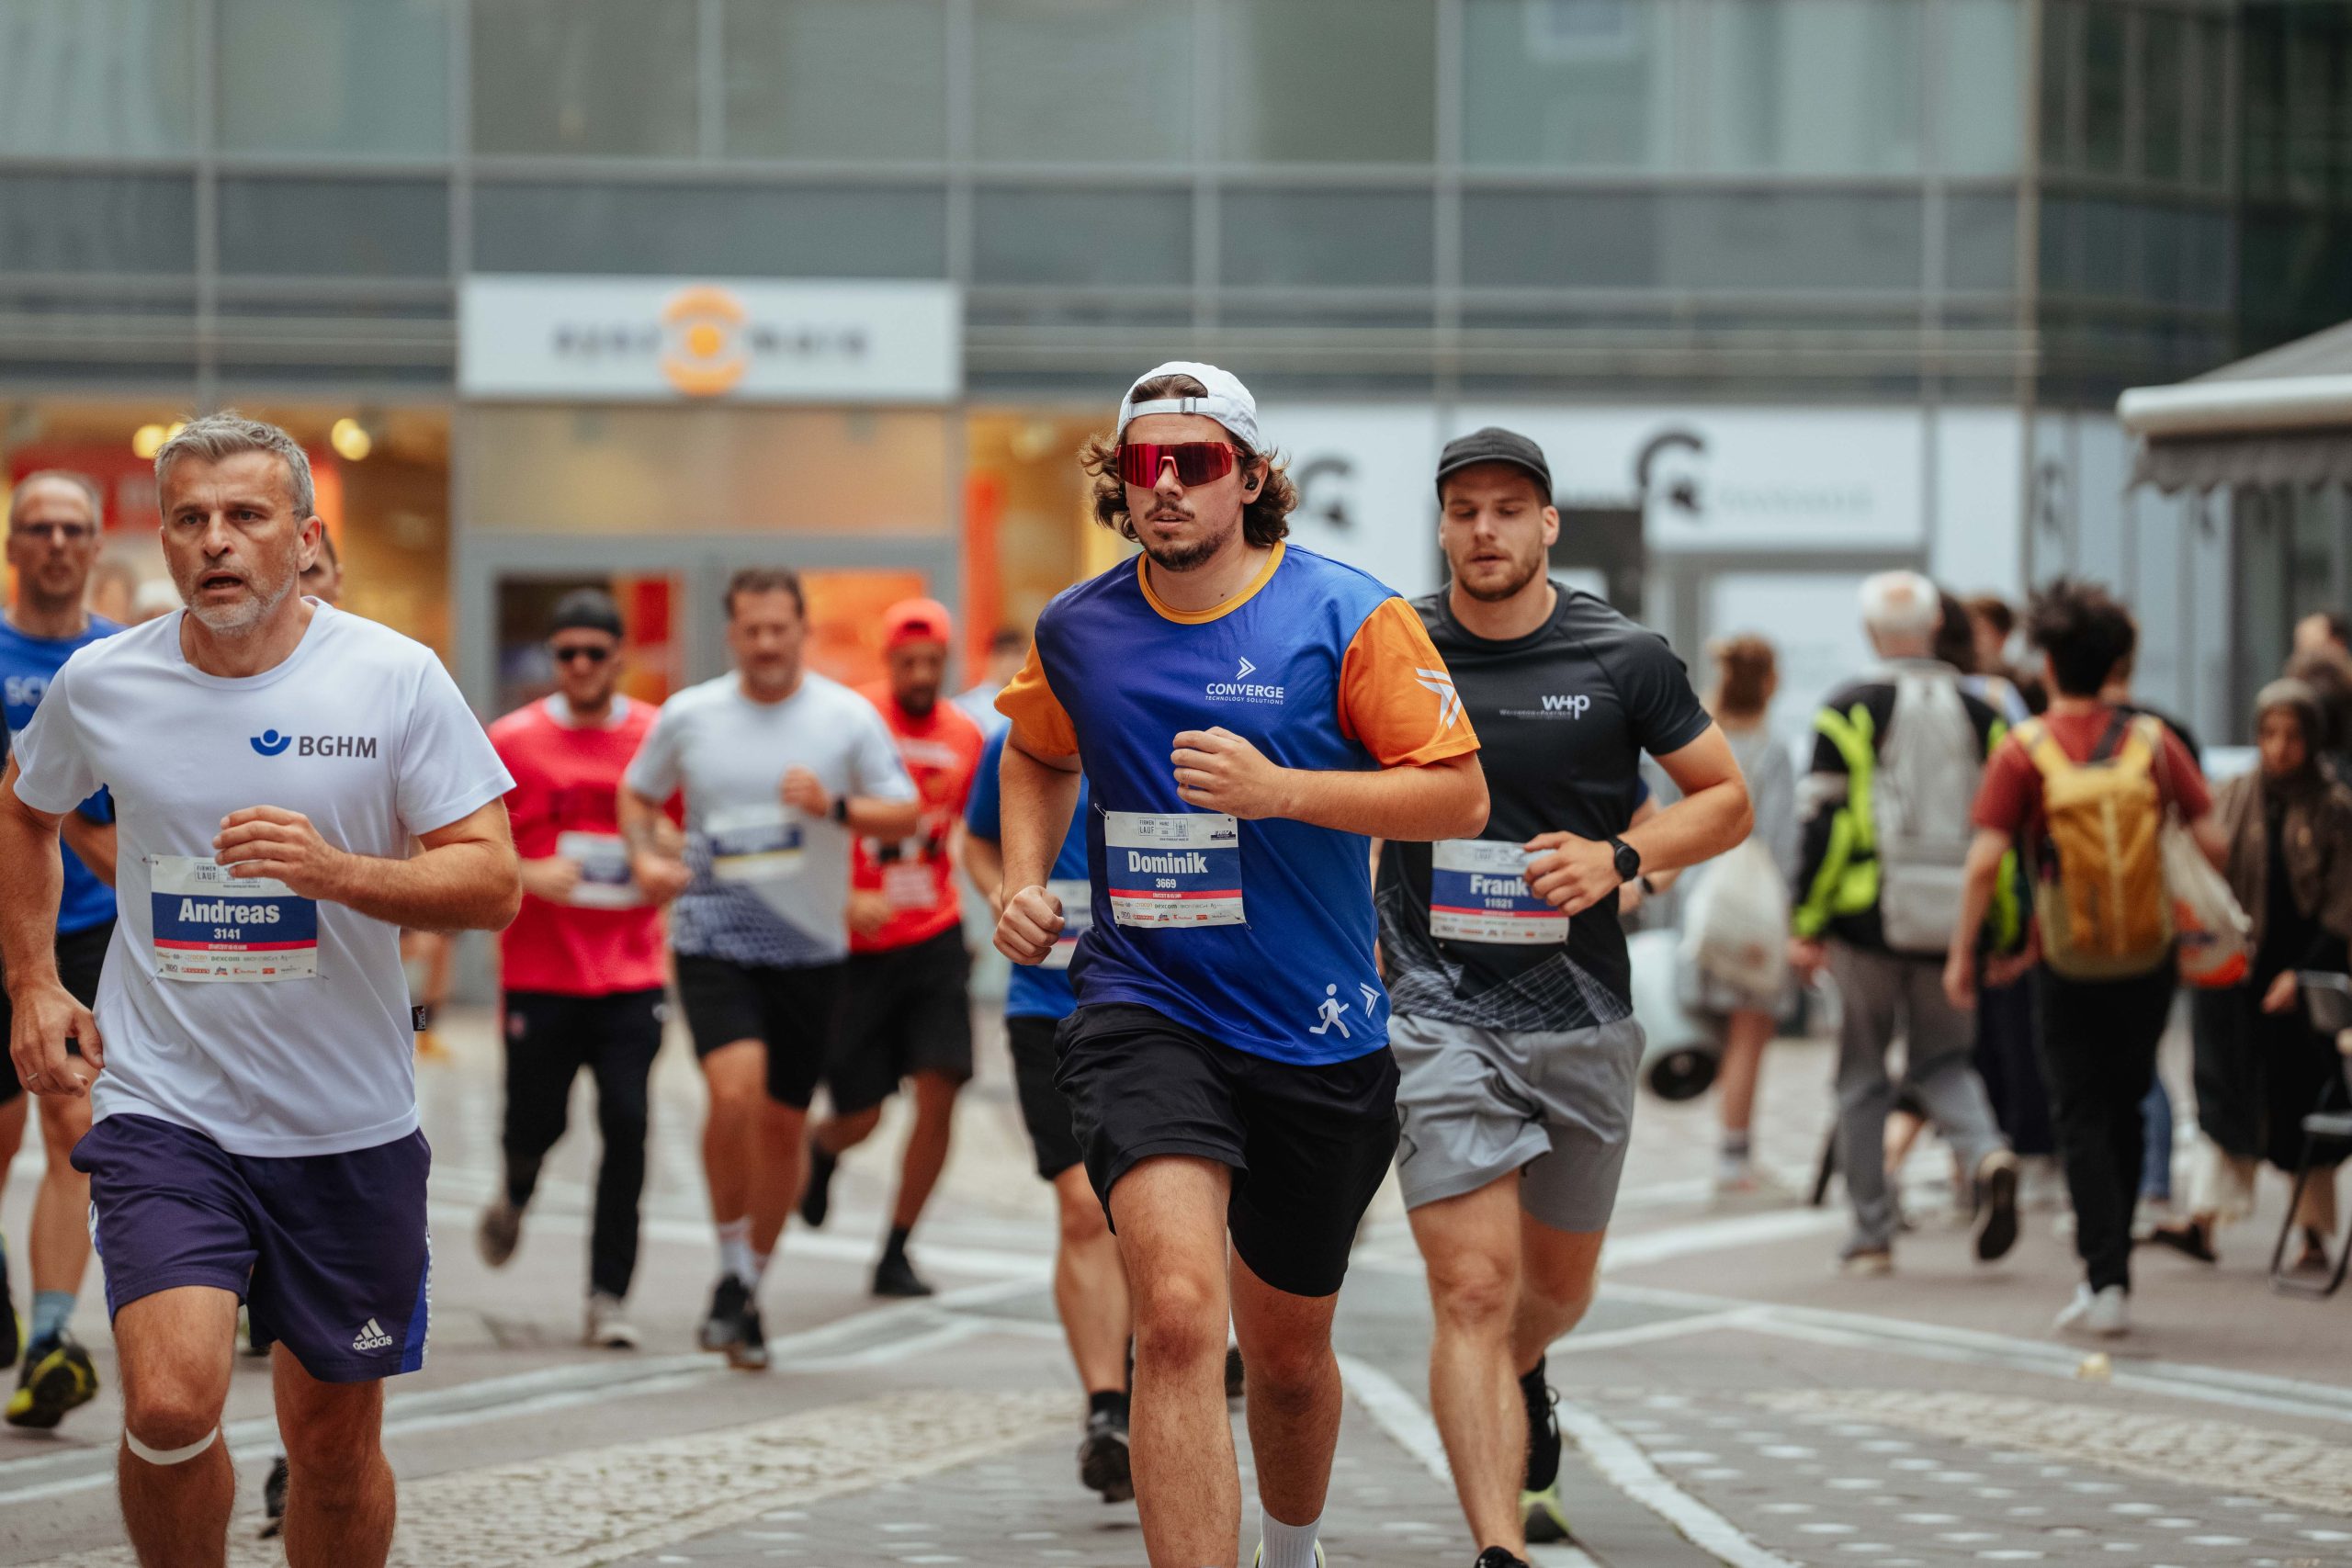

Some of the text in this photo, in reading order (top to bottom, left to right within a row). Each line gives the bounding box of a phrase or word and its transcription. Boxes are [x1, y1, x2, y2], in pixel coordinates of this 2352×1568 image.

[1206, 683, 1284, 698] CONVERGE
[1542, 694, 1590, 720] w+p
[299, 736, 377, 759] BGHM
[1127, 851, 1208, 874] Dominik
[198, 873, 216, 881] LAUF
[1156, 878, 1177, 889] 3669
[1470, 874, 1530, 897] Frank
[178, 897, 280, 924] Andreas
[213, 928, 241, 941] 3141
[353, 1335, 393, 1350] adidas
